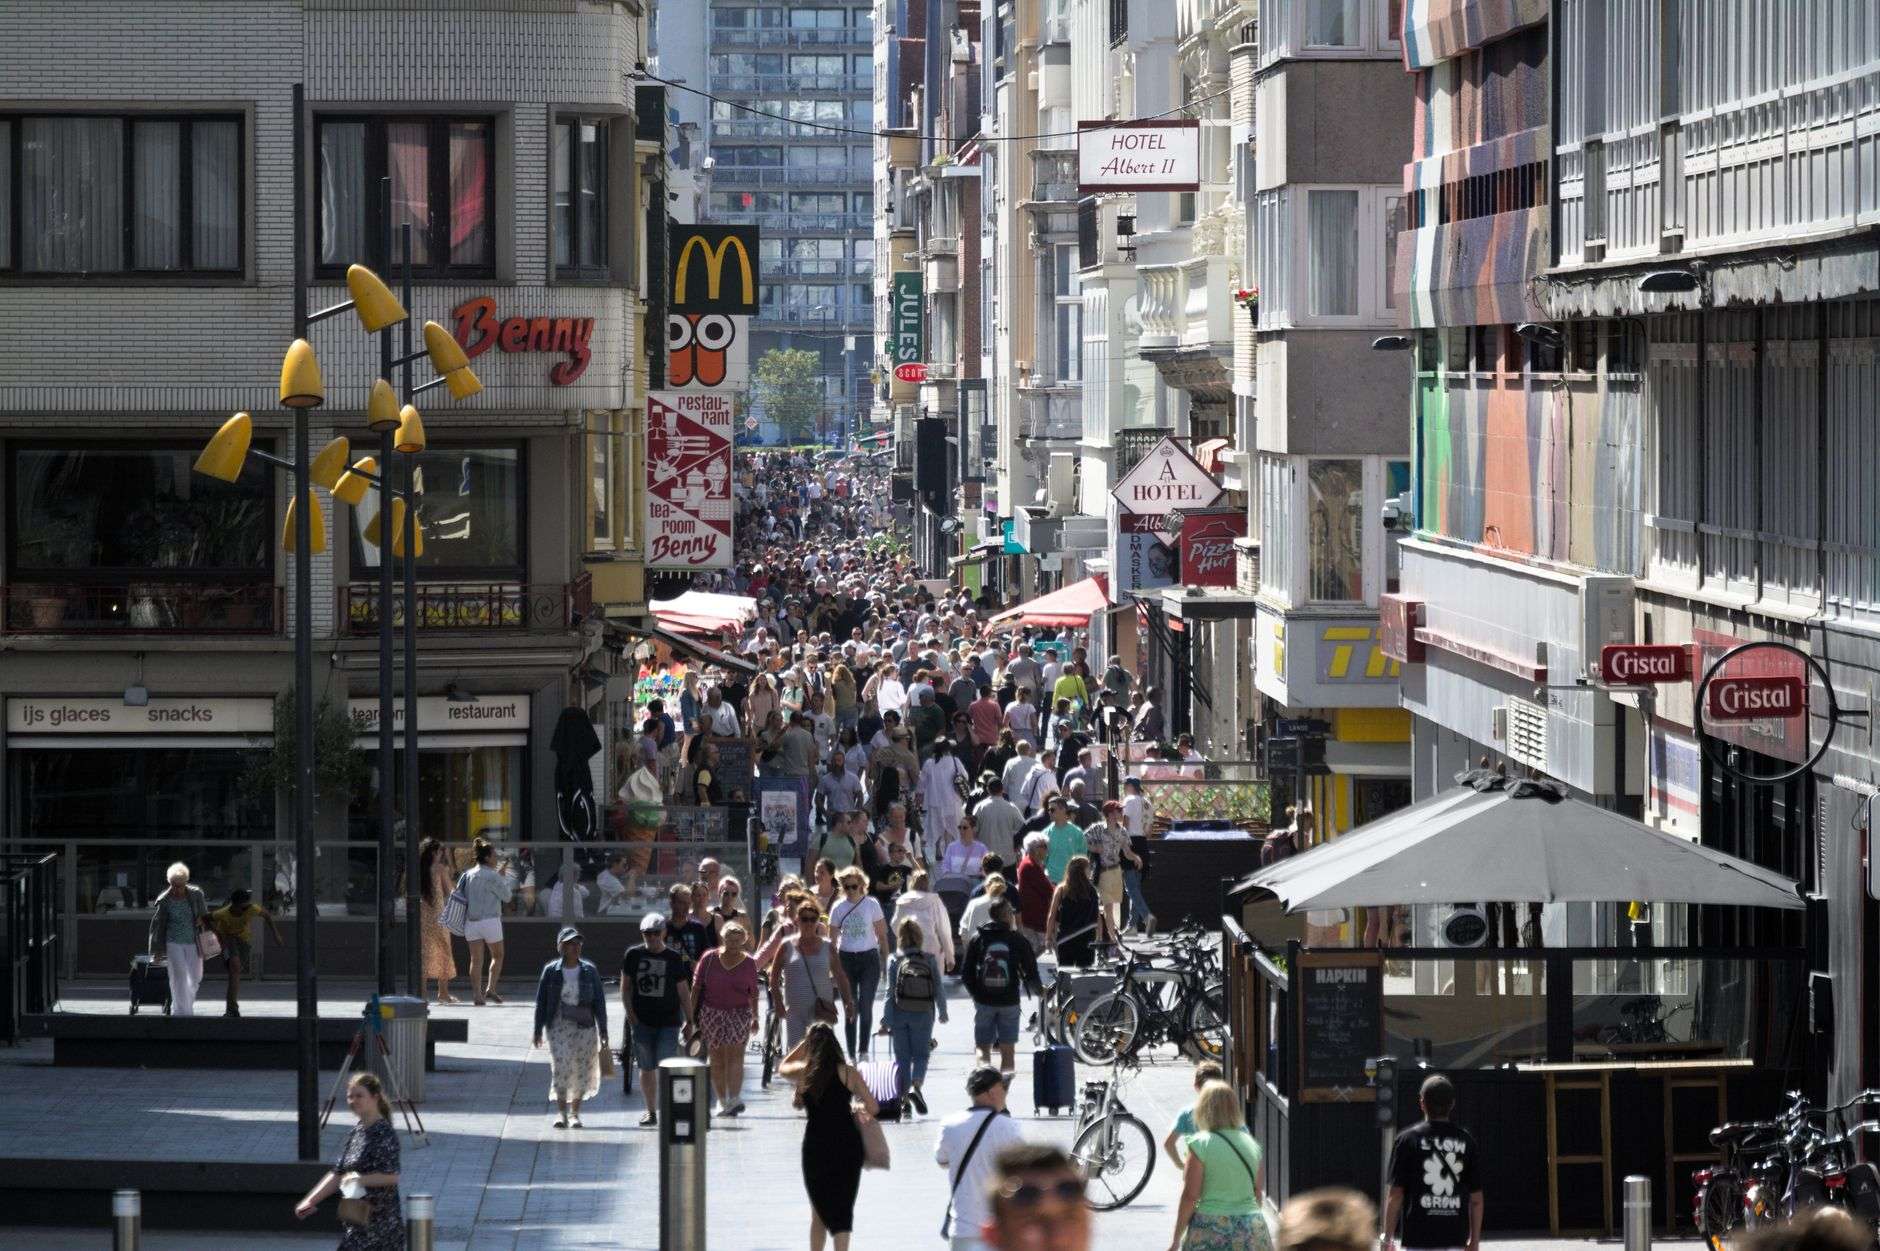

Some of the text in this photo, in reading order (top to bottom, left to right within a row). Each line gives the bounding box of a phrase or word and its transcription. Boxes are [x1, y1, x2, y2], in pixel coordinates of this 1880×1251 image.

[1112, 134, 1167, 150] HOTEL
[1101, 157, 1176, 176] Albert II
[898, 283, 919, 361] JULES
[452, 296, 595, 385] Benny
[678, 395, 729, 411] restau-
[702, 411, 730, 425] rant
[1160, 459, 1177, 480] A
[1133, 484, 1202, 500] HOTEL
[650, 502, 677, 518] tea-
[662, 520, 695, 534] room
[650, 533, 717, 565] Benny
[1198, 555, 1233, 574] Hut
[1611, 651, 1675, 678] Cristal
[1719, 684, 1791, 714] Cristal
[23, 706, 213, 725] ijs glaces snacks
[448, 703, 517, 719] restaurant
[1315, 969, 1367, 984] NAPKIN
